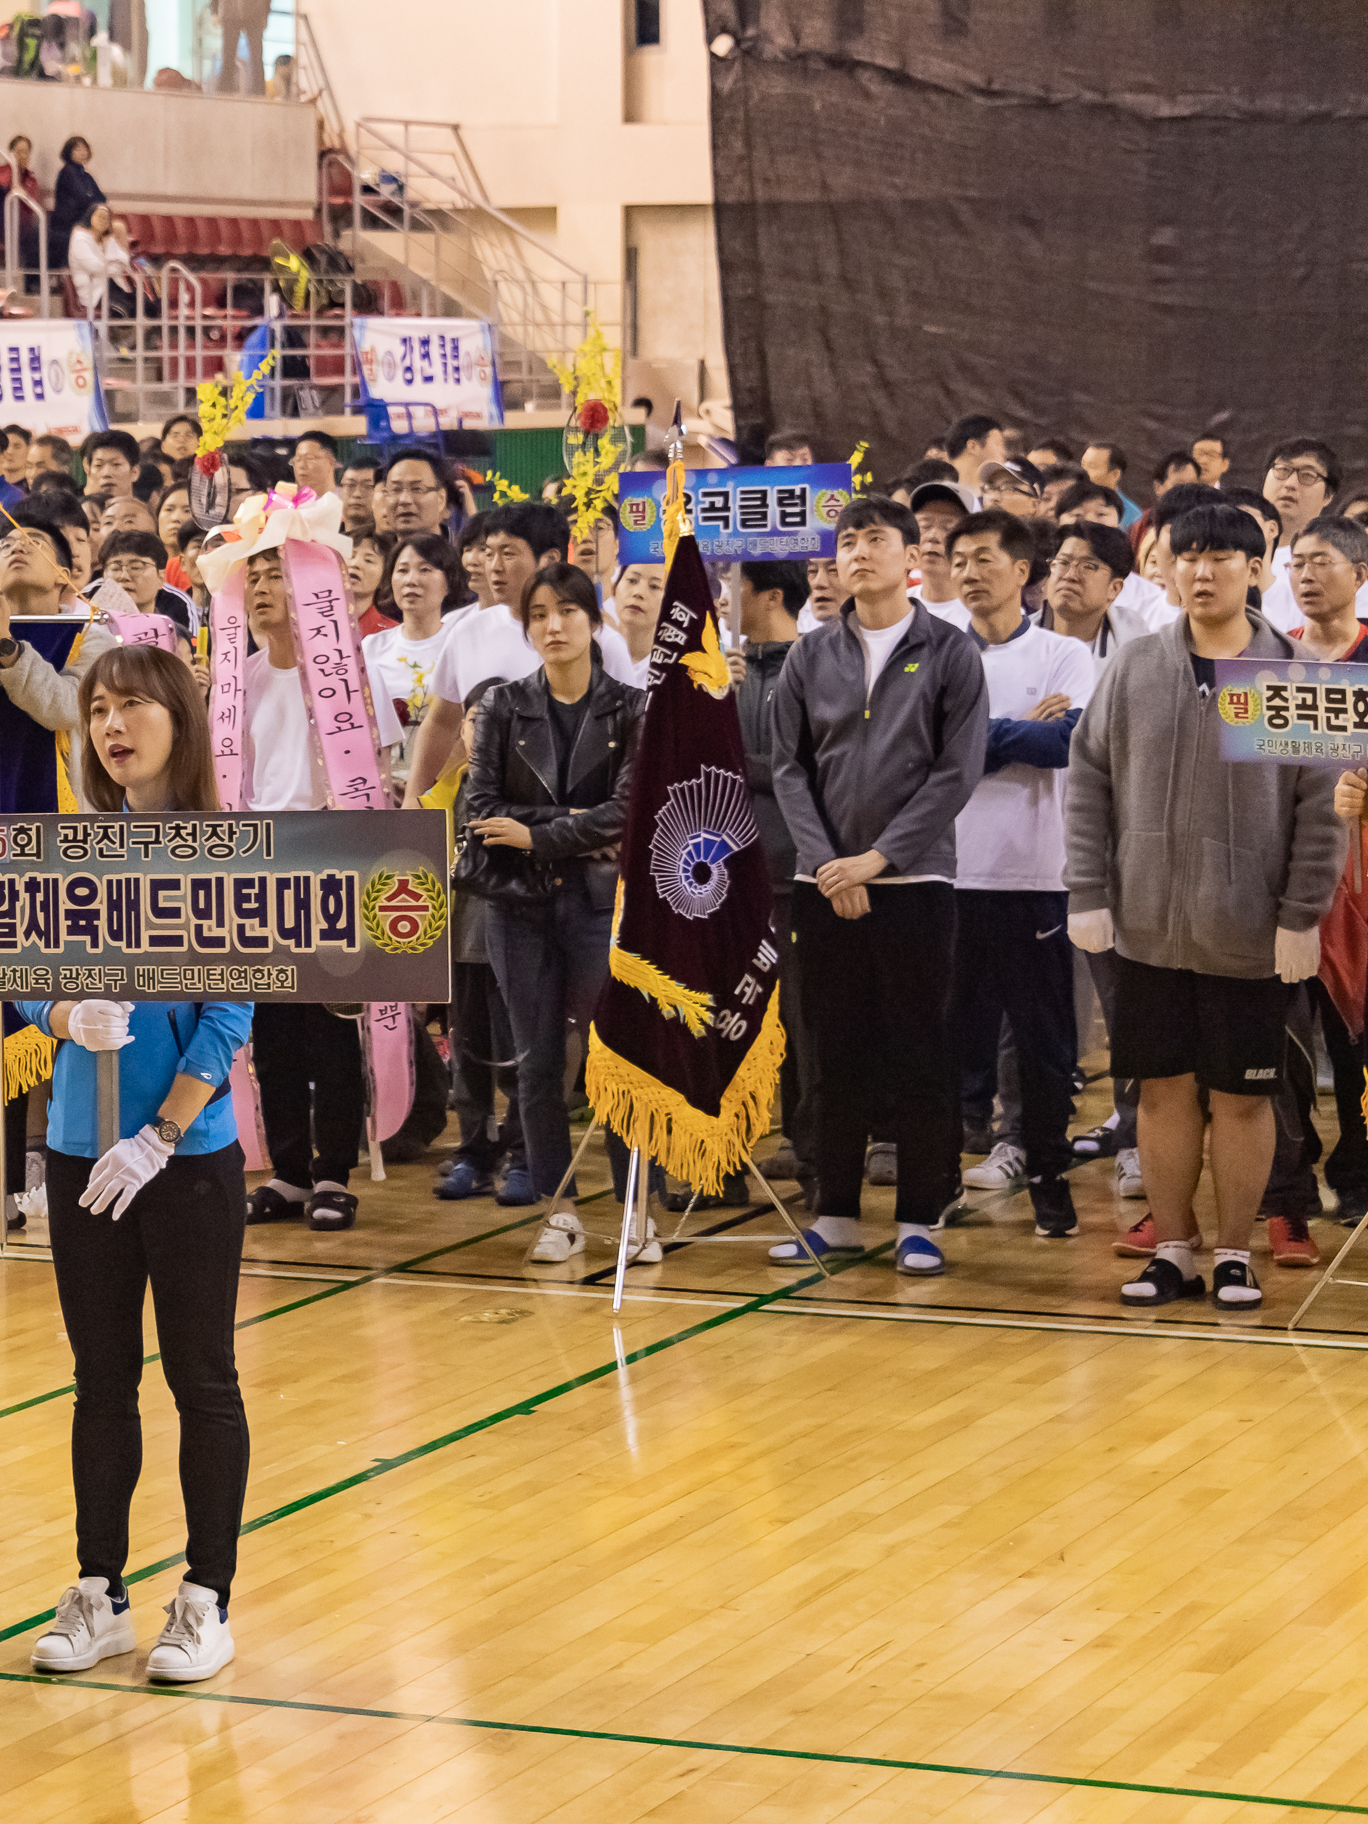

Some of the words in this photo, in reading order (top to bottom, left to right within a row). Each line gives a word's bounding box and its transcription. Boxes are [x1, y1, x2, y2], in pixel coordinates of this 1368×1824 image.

[628, 499, 648, 527] 필
[822, 493, 846, 519] 승
[1227, 691, 1250, 720] 필
[1254, 738, 1326, 758] 국민생활체육
[1329, 742, 1364, 760] 광진구
[337, 776, 378, 810] 콕
[56, 819, 275, 862] 광진구청장기
[377, 876, 432, 942] 승
[59, 965, 127, 993] 광진구
[134, 964, 297, 994] 배드민턴연합회
